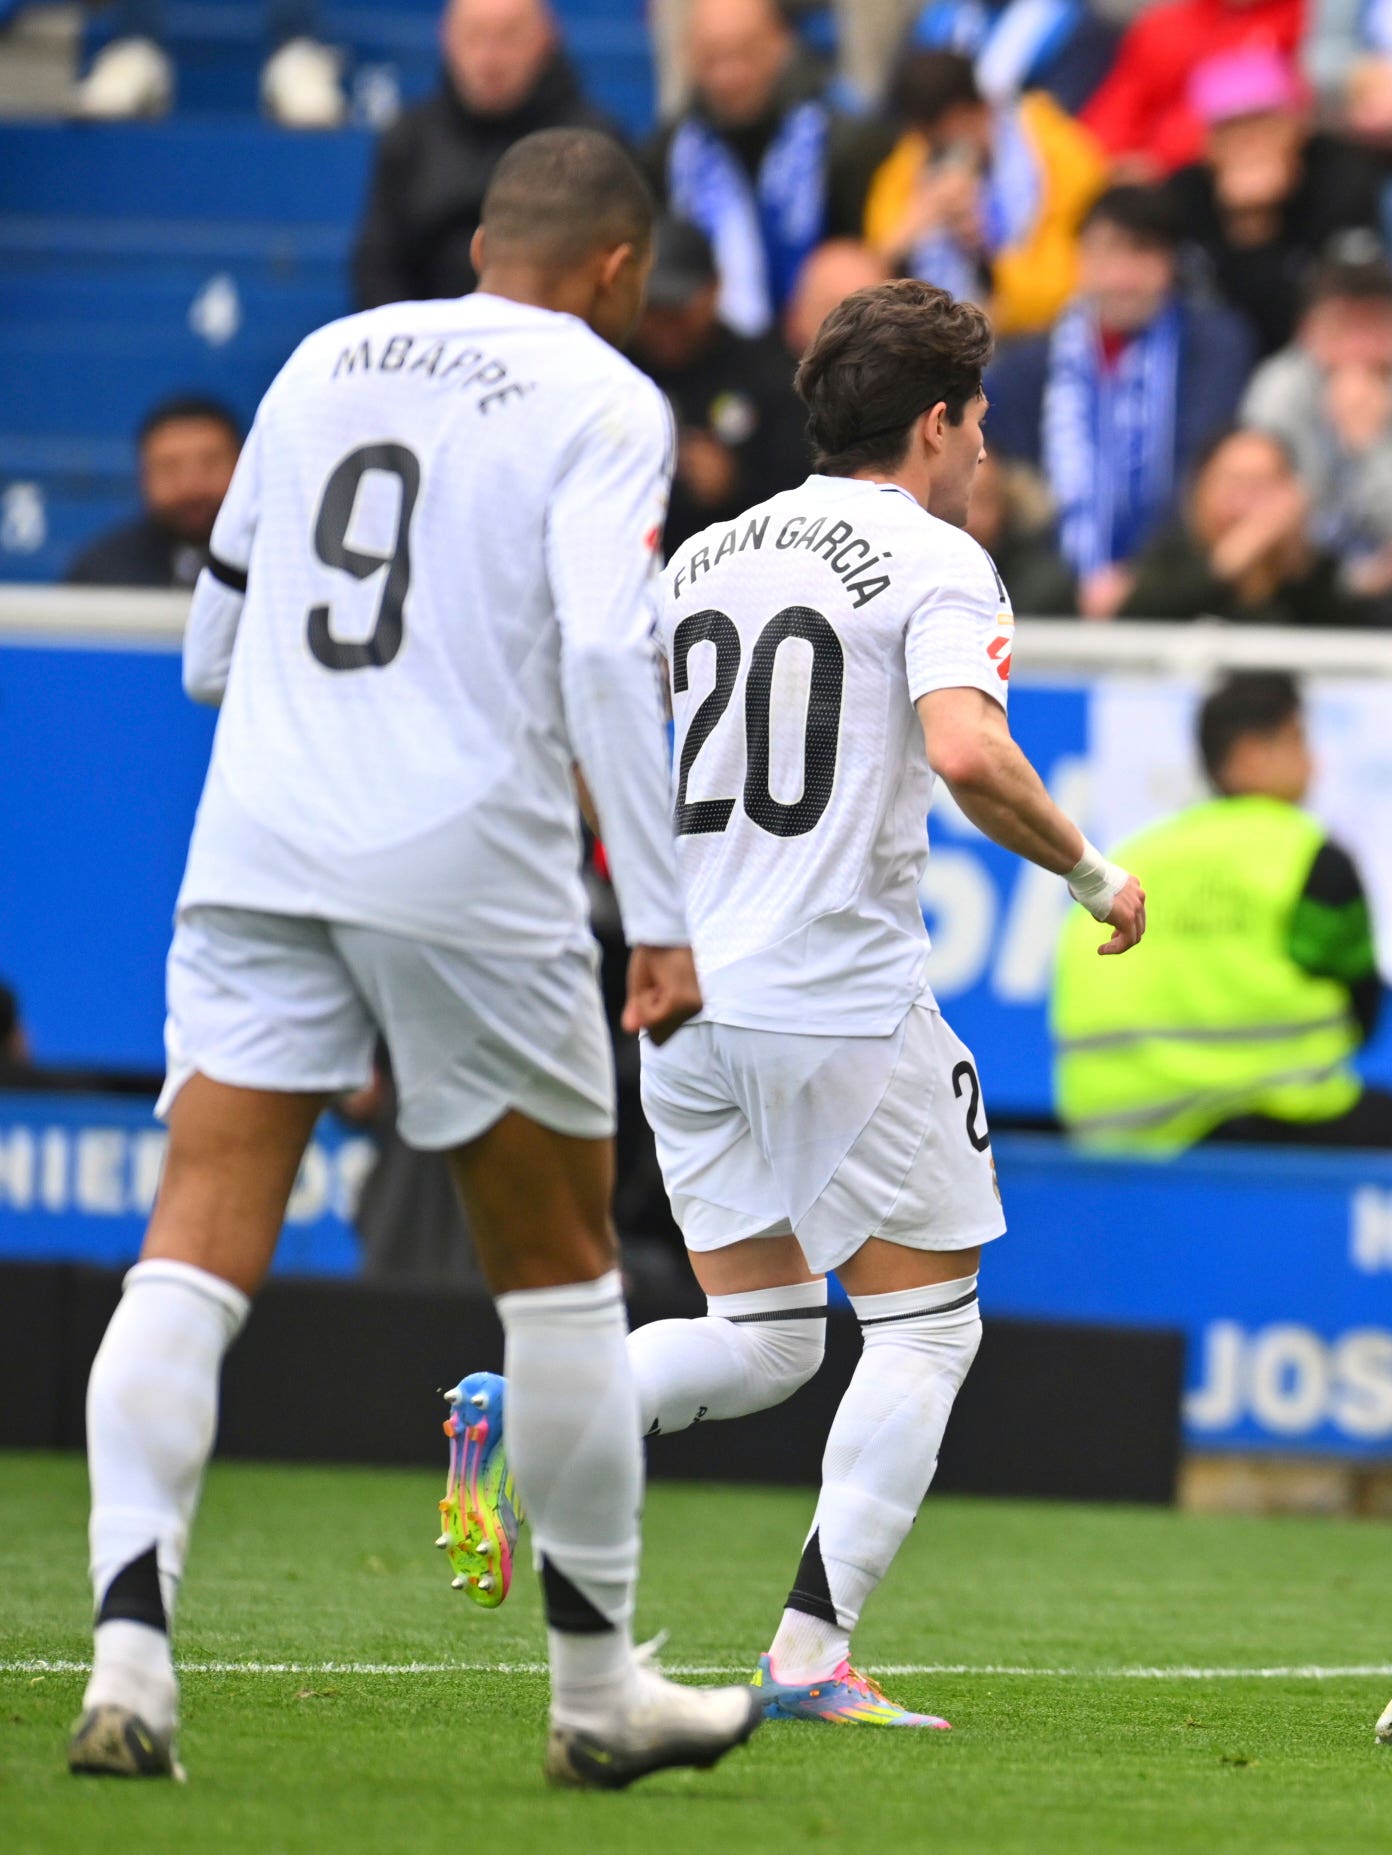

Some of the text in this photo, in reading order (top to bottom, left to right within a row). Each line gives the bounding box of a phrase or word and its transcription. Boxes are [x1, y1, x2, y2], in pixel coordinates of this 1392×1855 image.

[331, 335, 537, 415] MBAPPÉ
[307, 443, 421, 672] 9
[673, 516, 892, 609] FRAN GARCÍA
[672, 605, 844, 837] 20
